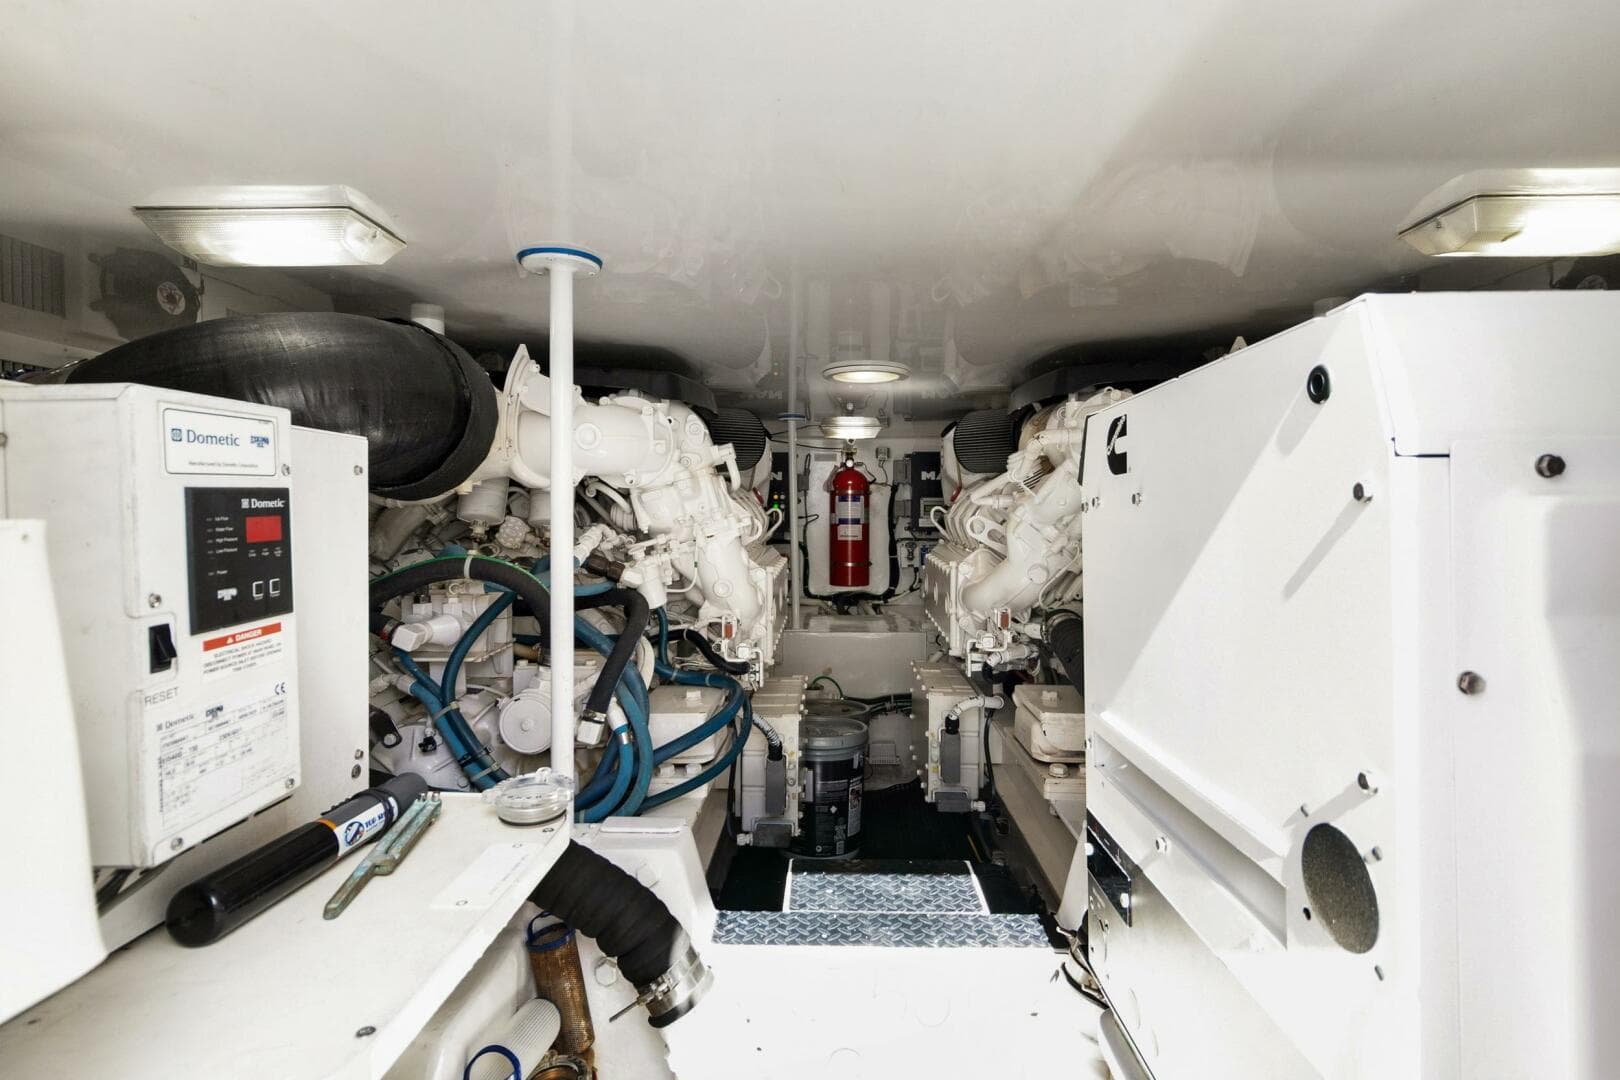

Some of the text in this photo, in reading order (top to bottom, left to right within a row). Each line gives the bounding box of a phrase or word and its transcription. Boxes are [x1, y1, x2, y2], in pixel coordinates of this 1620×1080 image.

[186, 429, 240, 447] Dometic
[251, 498, 285, 509] Dometic
[235, 629, 262, 642] DANGER
[144, 686, 179, 707] RESET
